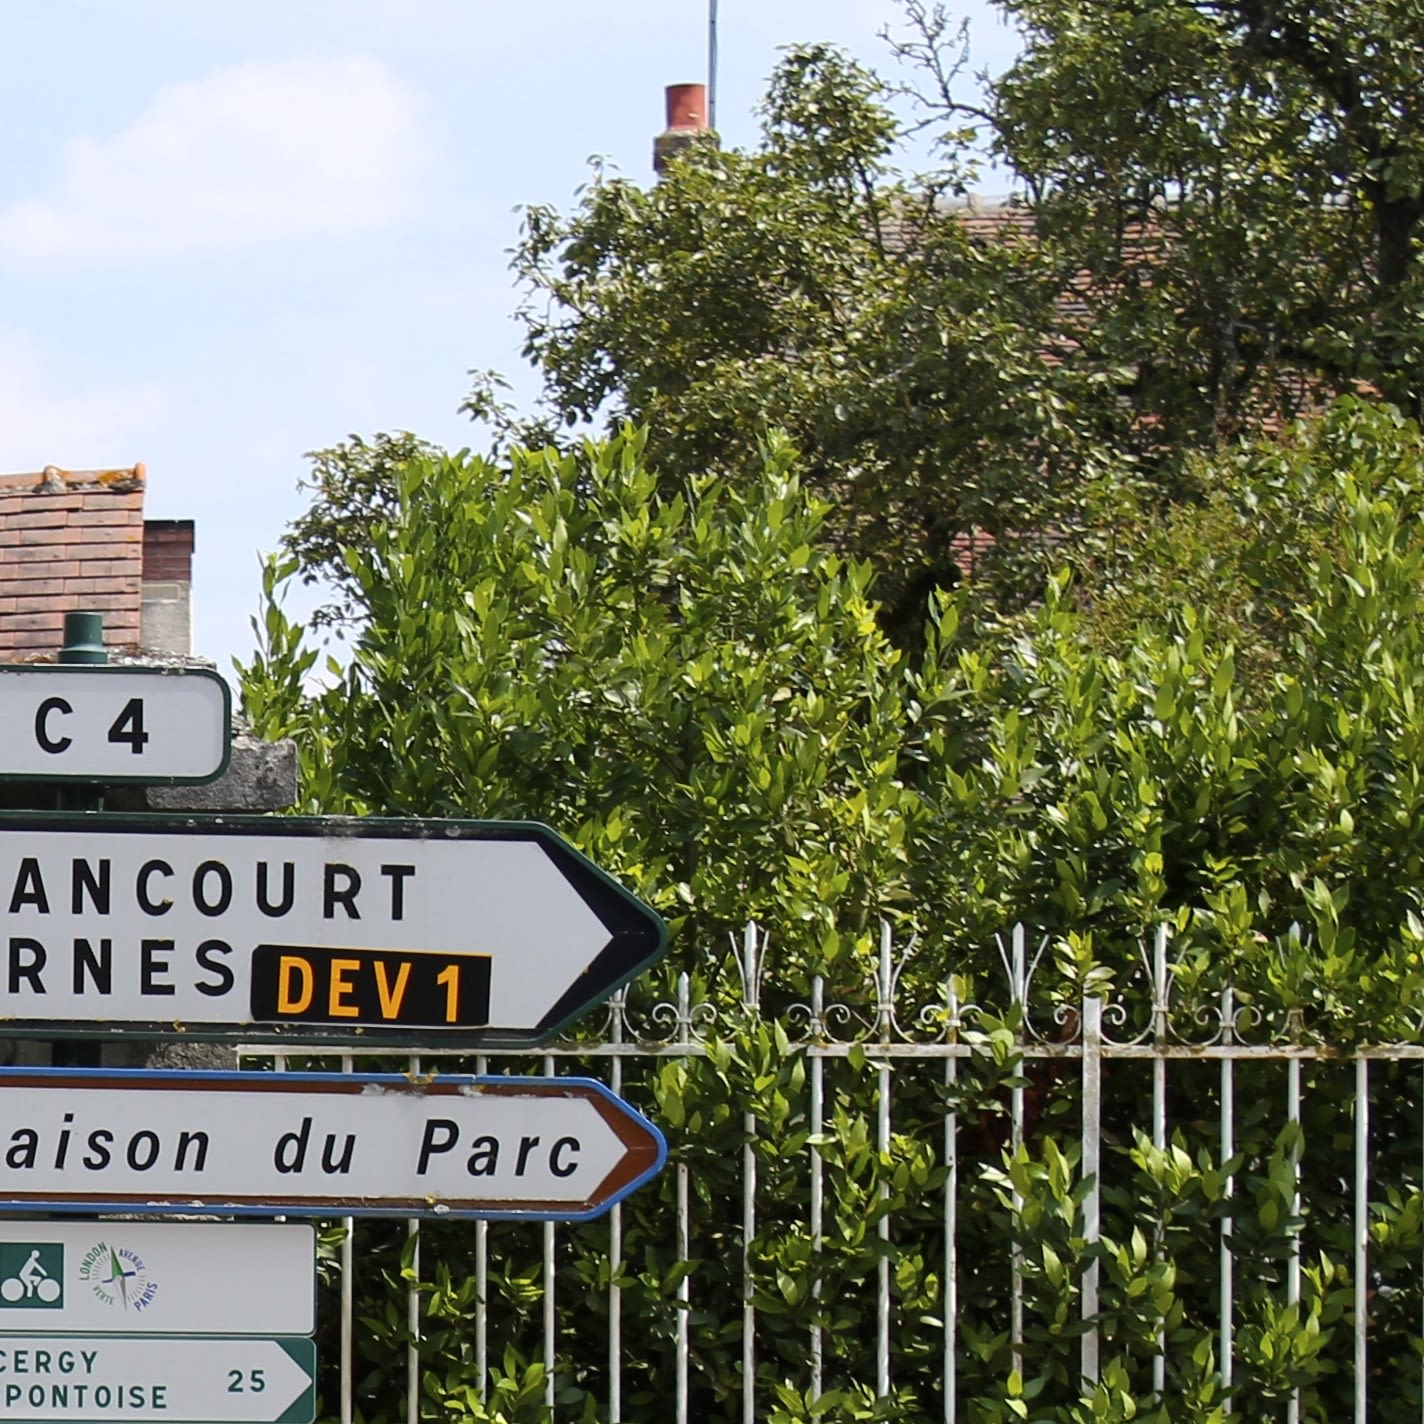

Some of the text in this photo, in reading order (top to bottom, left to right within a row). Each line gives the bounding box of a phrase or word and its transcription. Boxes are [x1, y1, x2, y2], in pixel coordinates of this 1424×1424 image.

[34, 696, 149, 755] C 4
[277, 955, 461, 1024] DEV 1
[274, 1116, 356, 1175] du
[416, 1118, 581, 1178] Parc
[79, 1241, 108, 1281] LONDON
[133, 1281, 159, 1312] PARIS
[227, 1369, 266, 1393] 25
